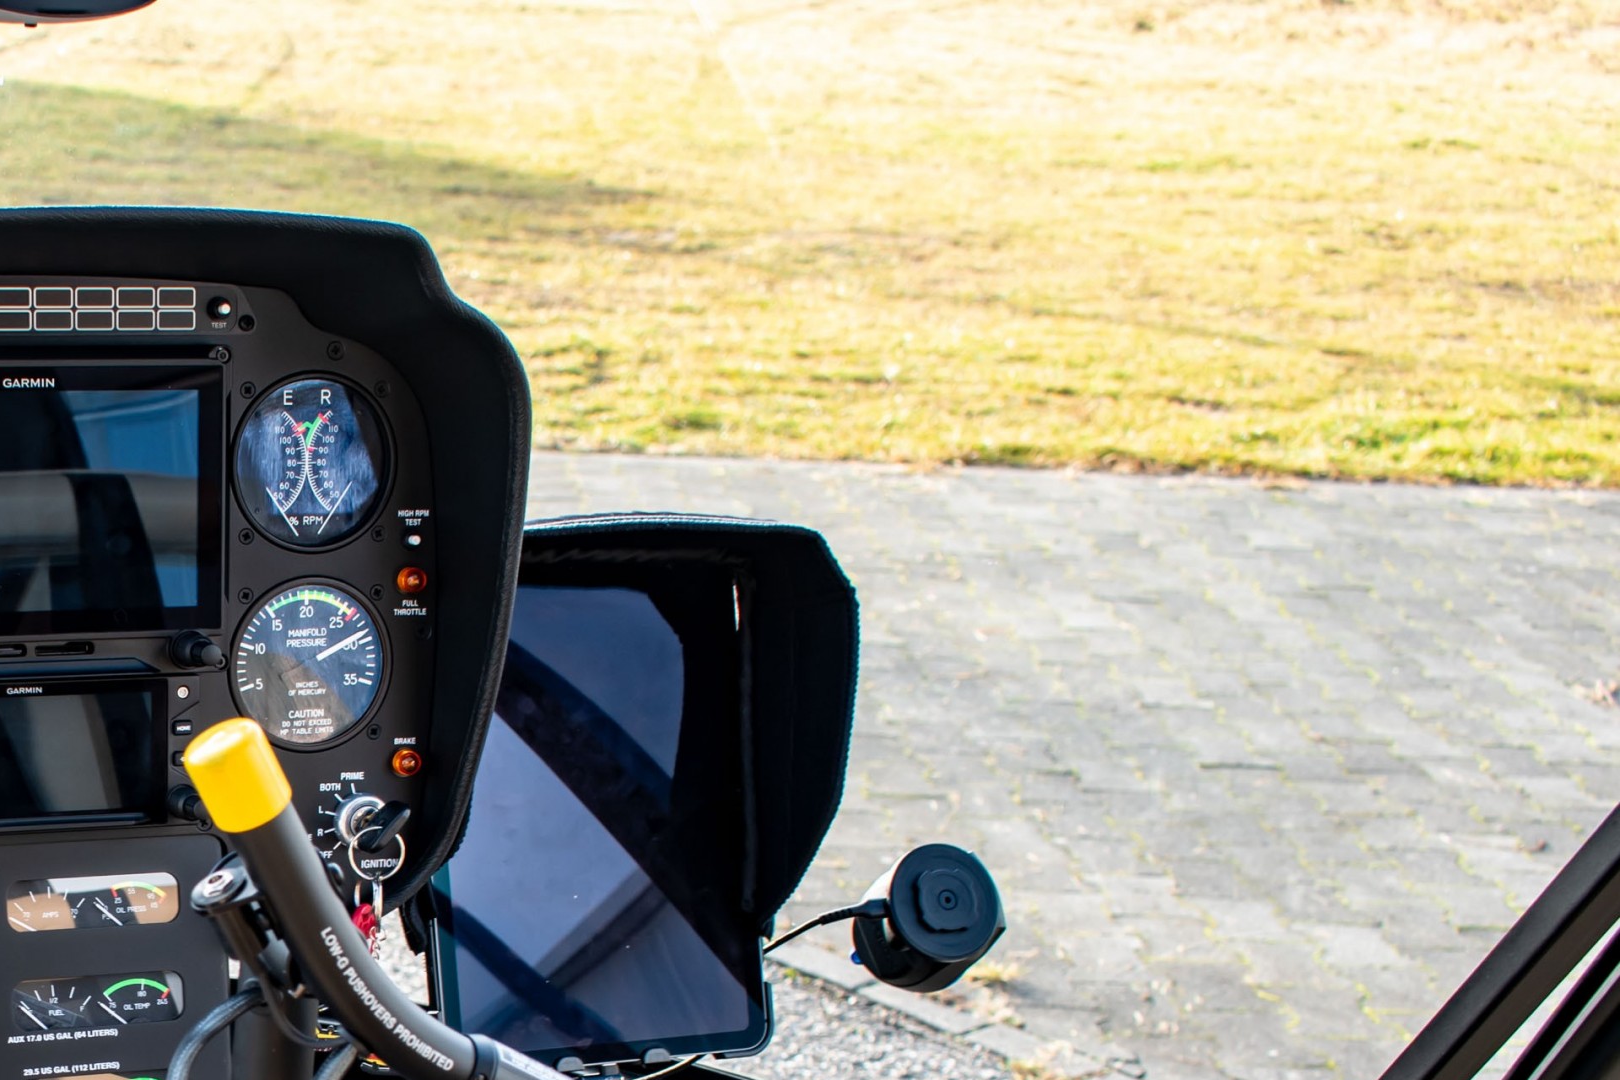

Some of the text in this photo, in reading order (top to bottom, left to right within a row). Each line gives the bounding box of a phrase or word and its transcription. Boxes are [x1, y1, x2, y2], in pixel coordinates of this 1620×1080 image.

[2, 378, 55, 388] GARMIN
[284, 390, 293, 405] E
[321, 389, 331, 404] R
[303, 516, 323, 524] RPM
[405, 518, 421, 526] TEST
[299, 606, 313, 618] 20
[393, 608, 427, 616] THROTTLE
[272, 619, 282, 631] 15
[329, 617, 344, 628] 25
[288, 628, 327, 637] MANIFOLD
[287, 638, 327, 647] PRESSURE
[255, 643, 265, 654] 10
[343, 674, 357, 685] 35
[6, 686, 42, 695] GARMIN
[289, 709, 324, 718] CAUTION
[394, 737, 416, 745] BRAKE
[340, 772, 365, 781] PRIME
[319, 783, 341, 791] BOTH
[361, 859, 399, 869] IGNITION
[127, 905, 147, 913] PRESS
[320, 927, 454, 1071] LOW-G PUSHOVERS PROHIBITED
[8, 1035, 25, 1044] AUX
[26, 1034, 42, 1043] 17.0
[44, 1033, 54, 1041] US
[56, 1031, 73, 1040] GAL
[88, 1028, 118, 1038] LITERS)
[53, 1065, 70, 1073] GAL
[72, 1063, 87, 1073] (112
[89, 1062, 120, 1071] LITERS)
